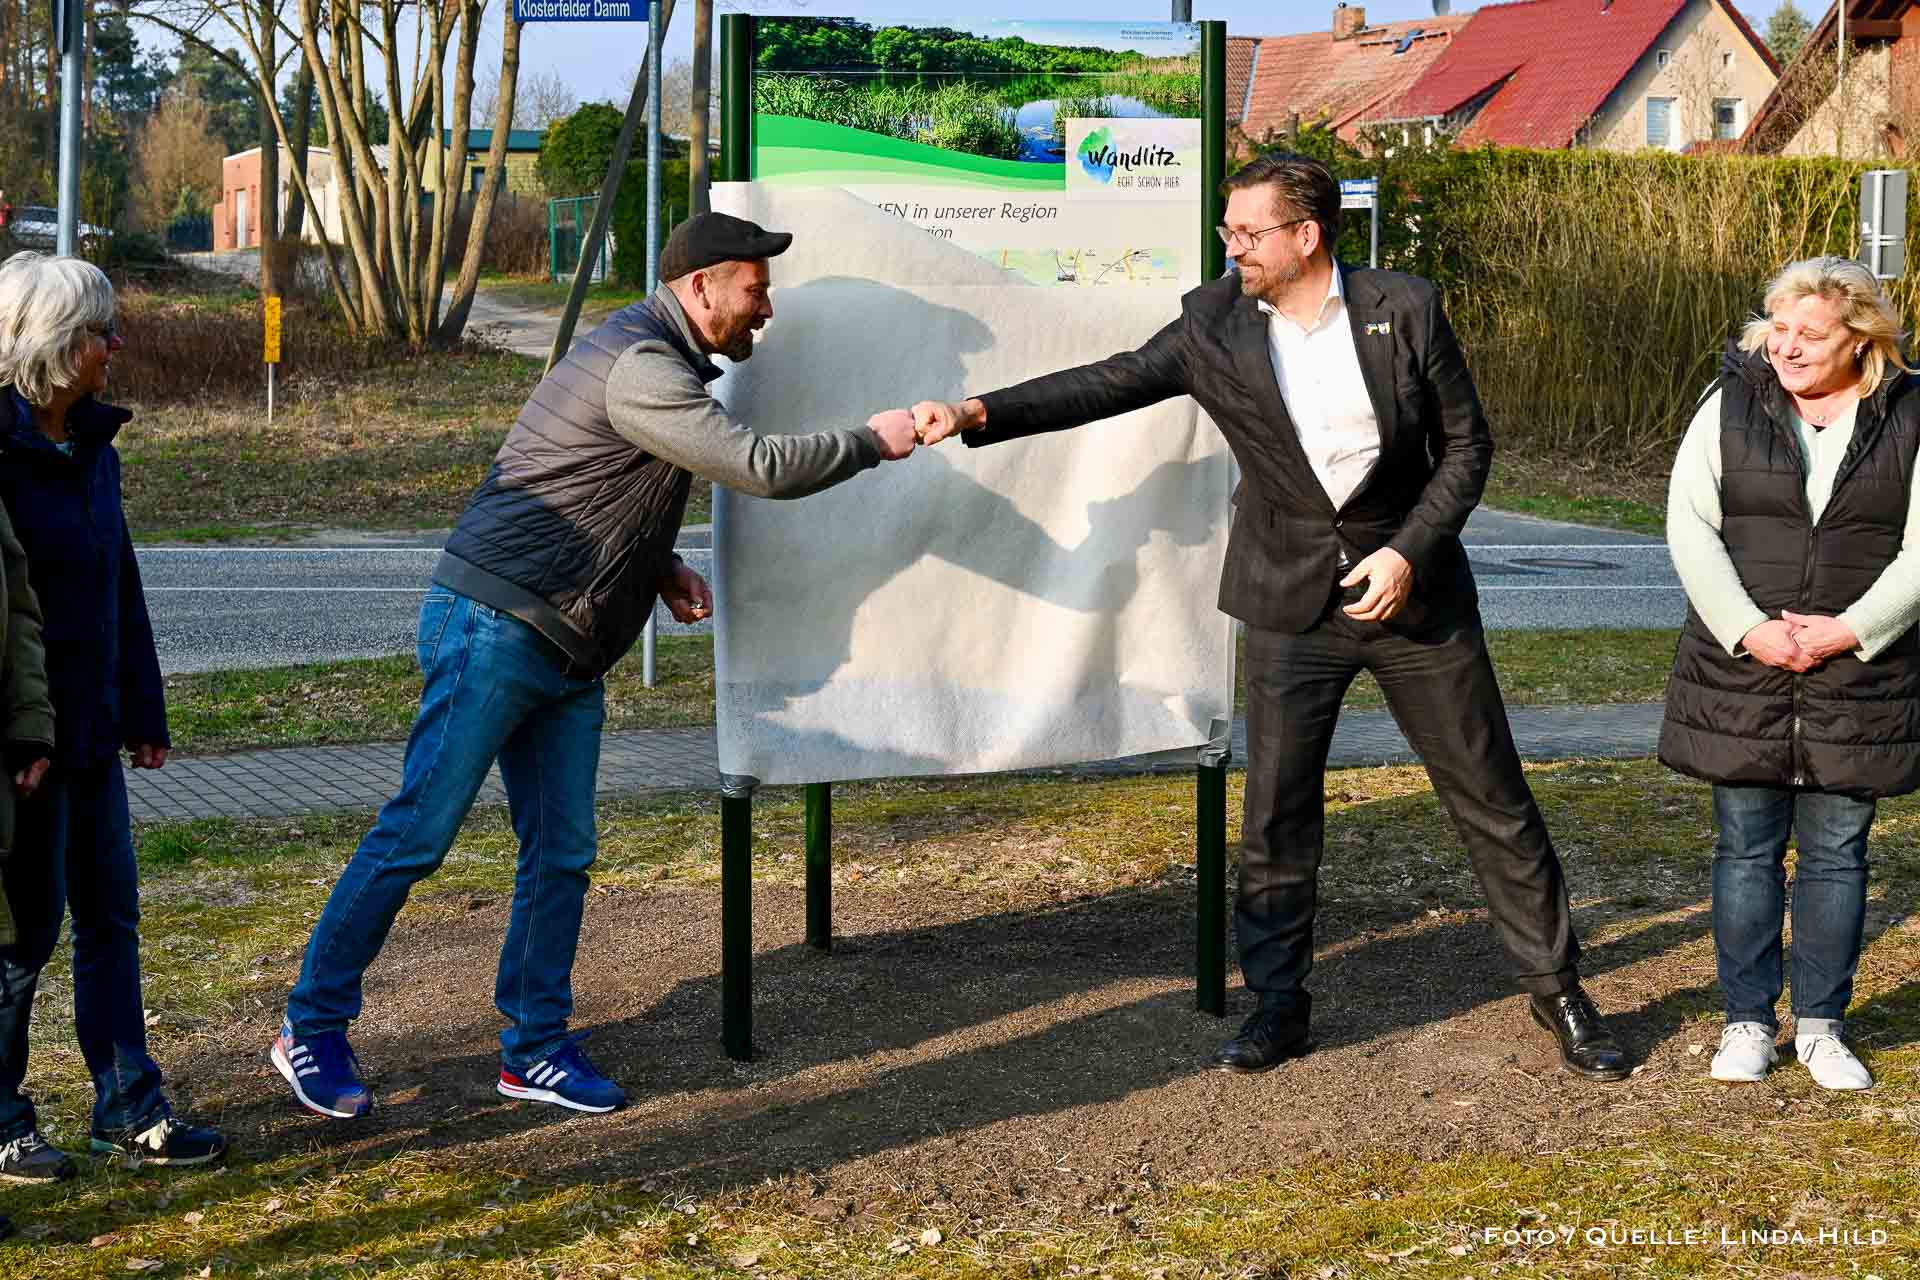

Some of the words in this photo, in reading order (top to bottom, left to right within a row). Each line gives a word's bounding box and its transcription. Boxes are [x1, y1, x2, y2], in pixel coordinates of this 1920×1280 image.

[519, 0, 591, 17] Klosterfelder
[594, 0, 630, 17] Damm
[1117, 176, 1134, 188] ECHT
[1164, 176, 1181, 188] HIER
[878, 203, 908, 219] EN
[913, 203, 928, 219] in
[934, 206, 996, 219] unserer
[1001, 202, 1057, 223] Region
[927, 225, 953, 239] ion
